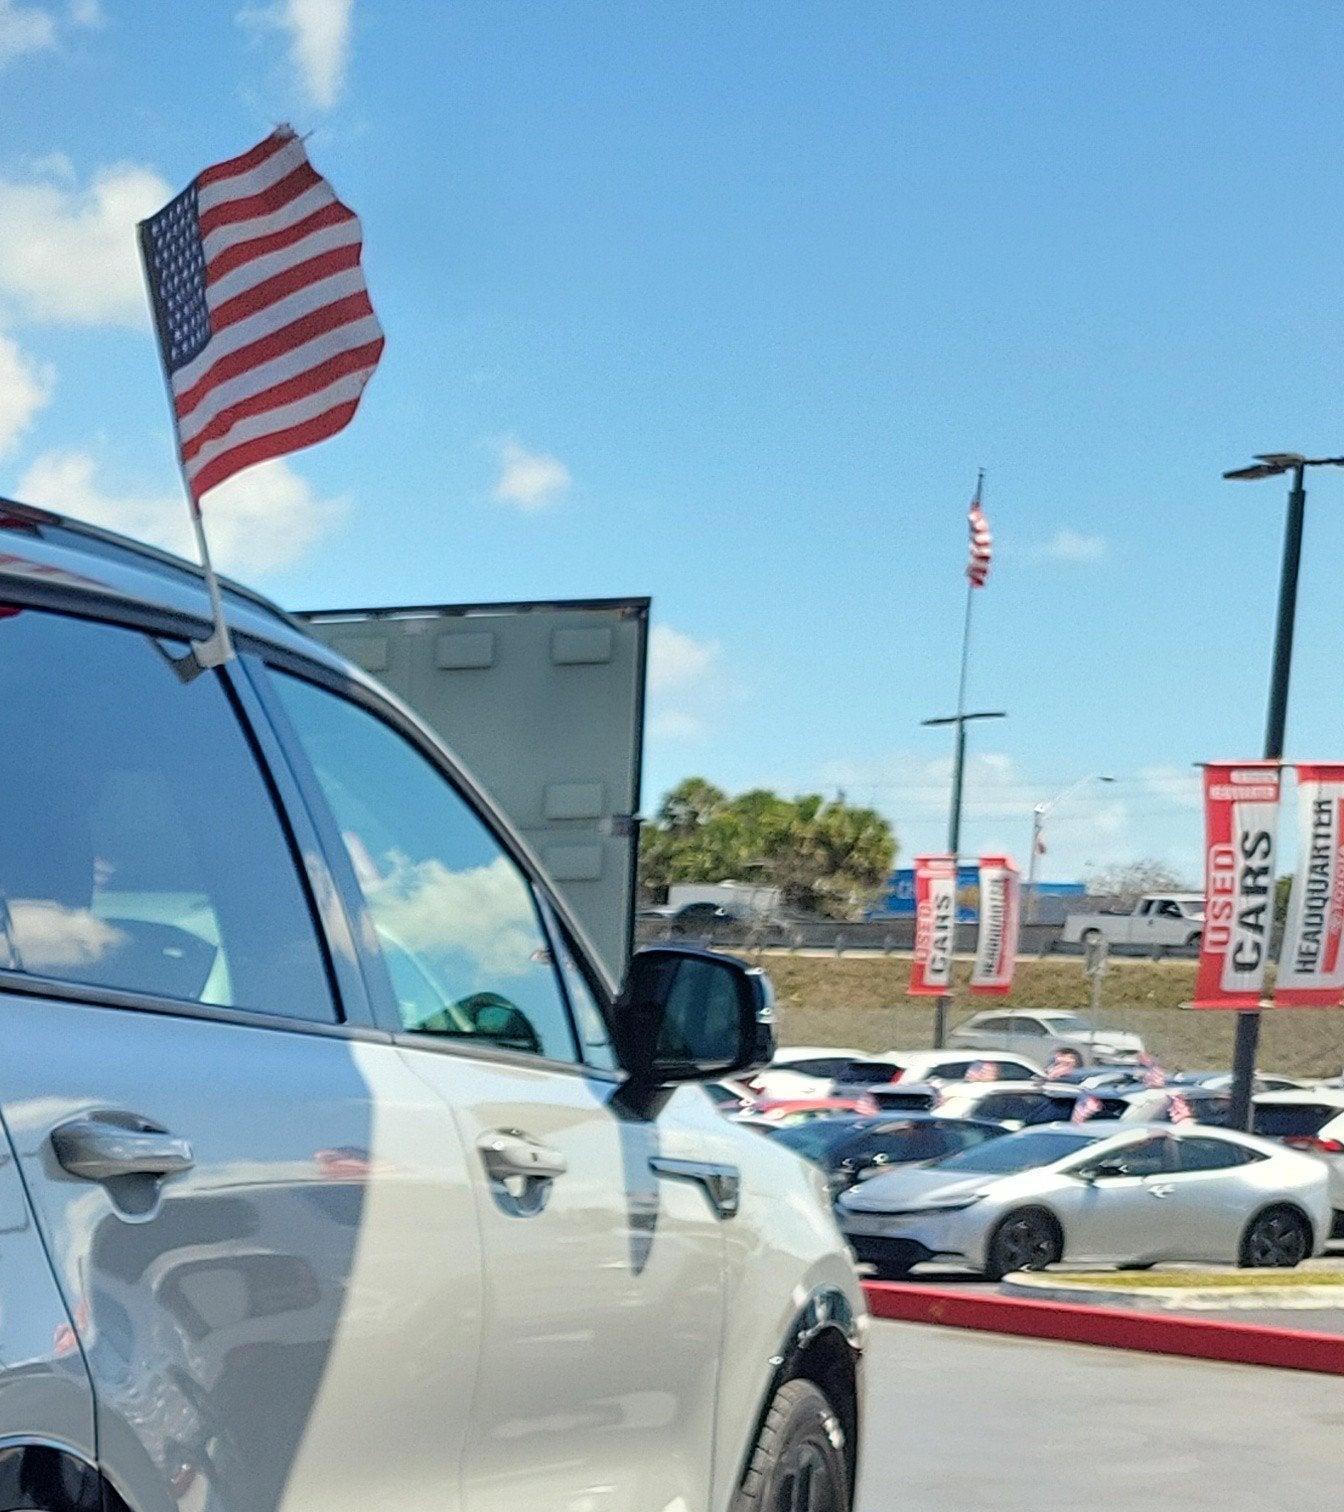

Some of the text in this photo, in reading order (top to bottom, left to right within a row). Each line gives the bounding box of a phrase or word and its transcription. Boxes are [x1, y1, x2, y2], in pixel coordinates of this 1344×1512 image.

[931, 893, 950, 973] CARS
[1208, 847, 1235, 948] USED
[1232, 831, 1272, 973] CARS
[1294, 800, 1333, 974] HEADQUARTER
